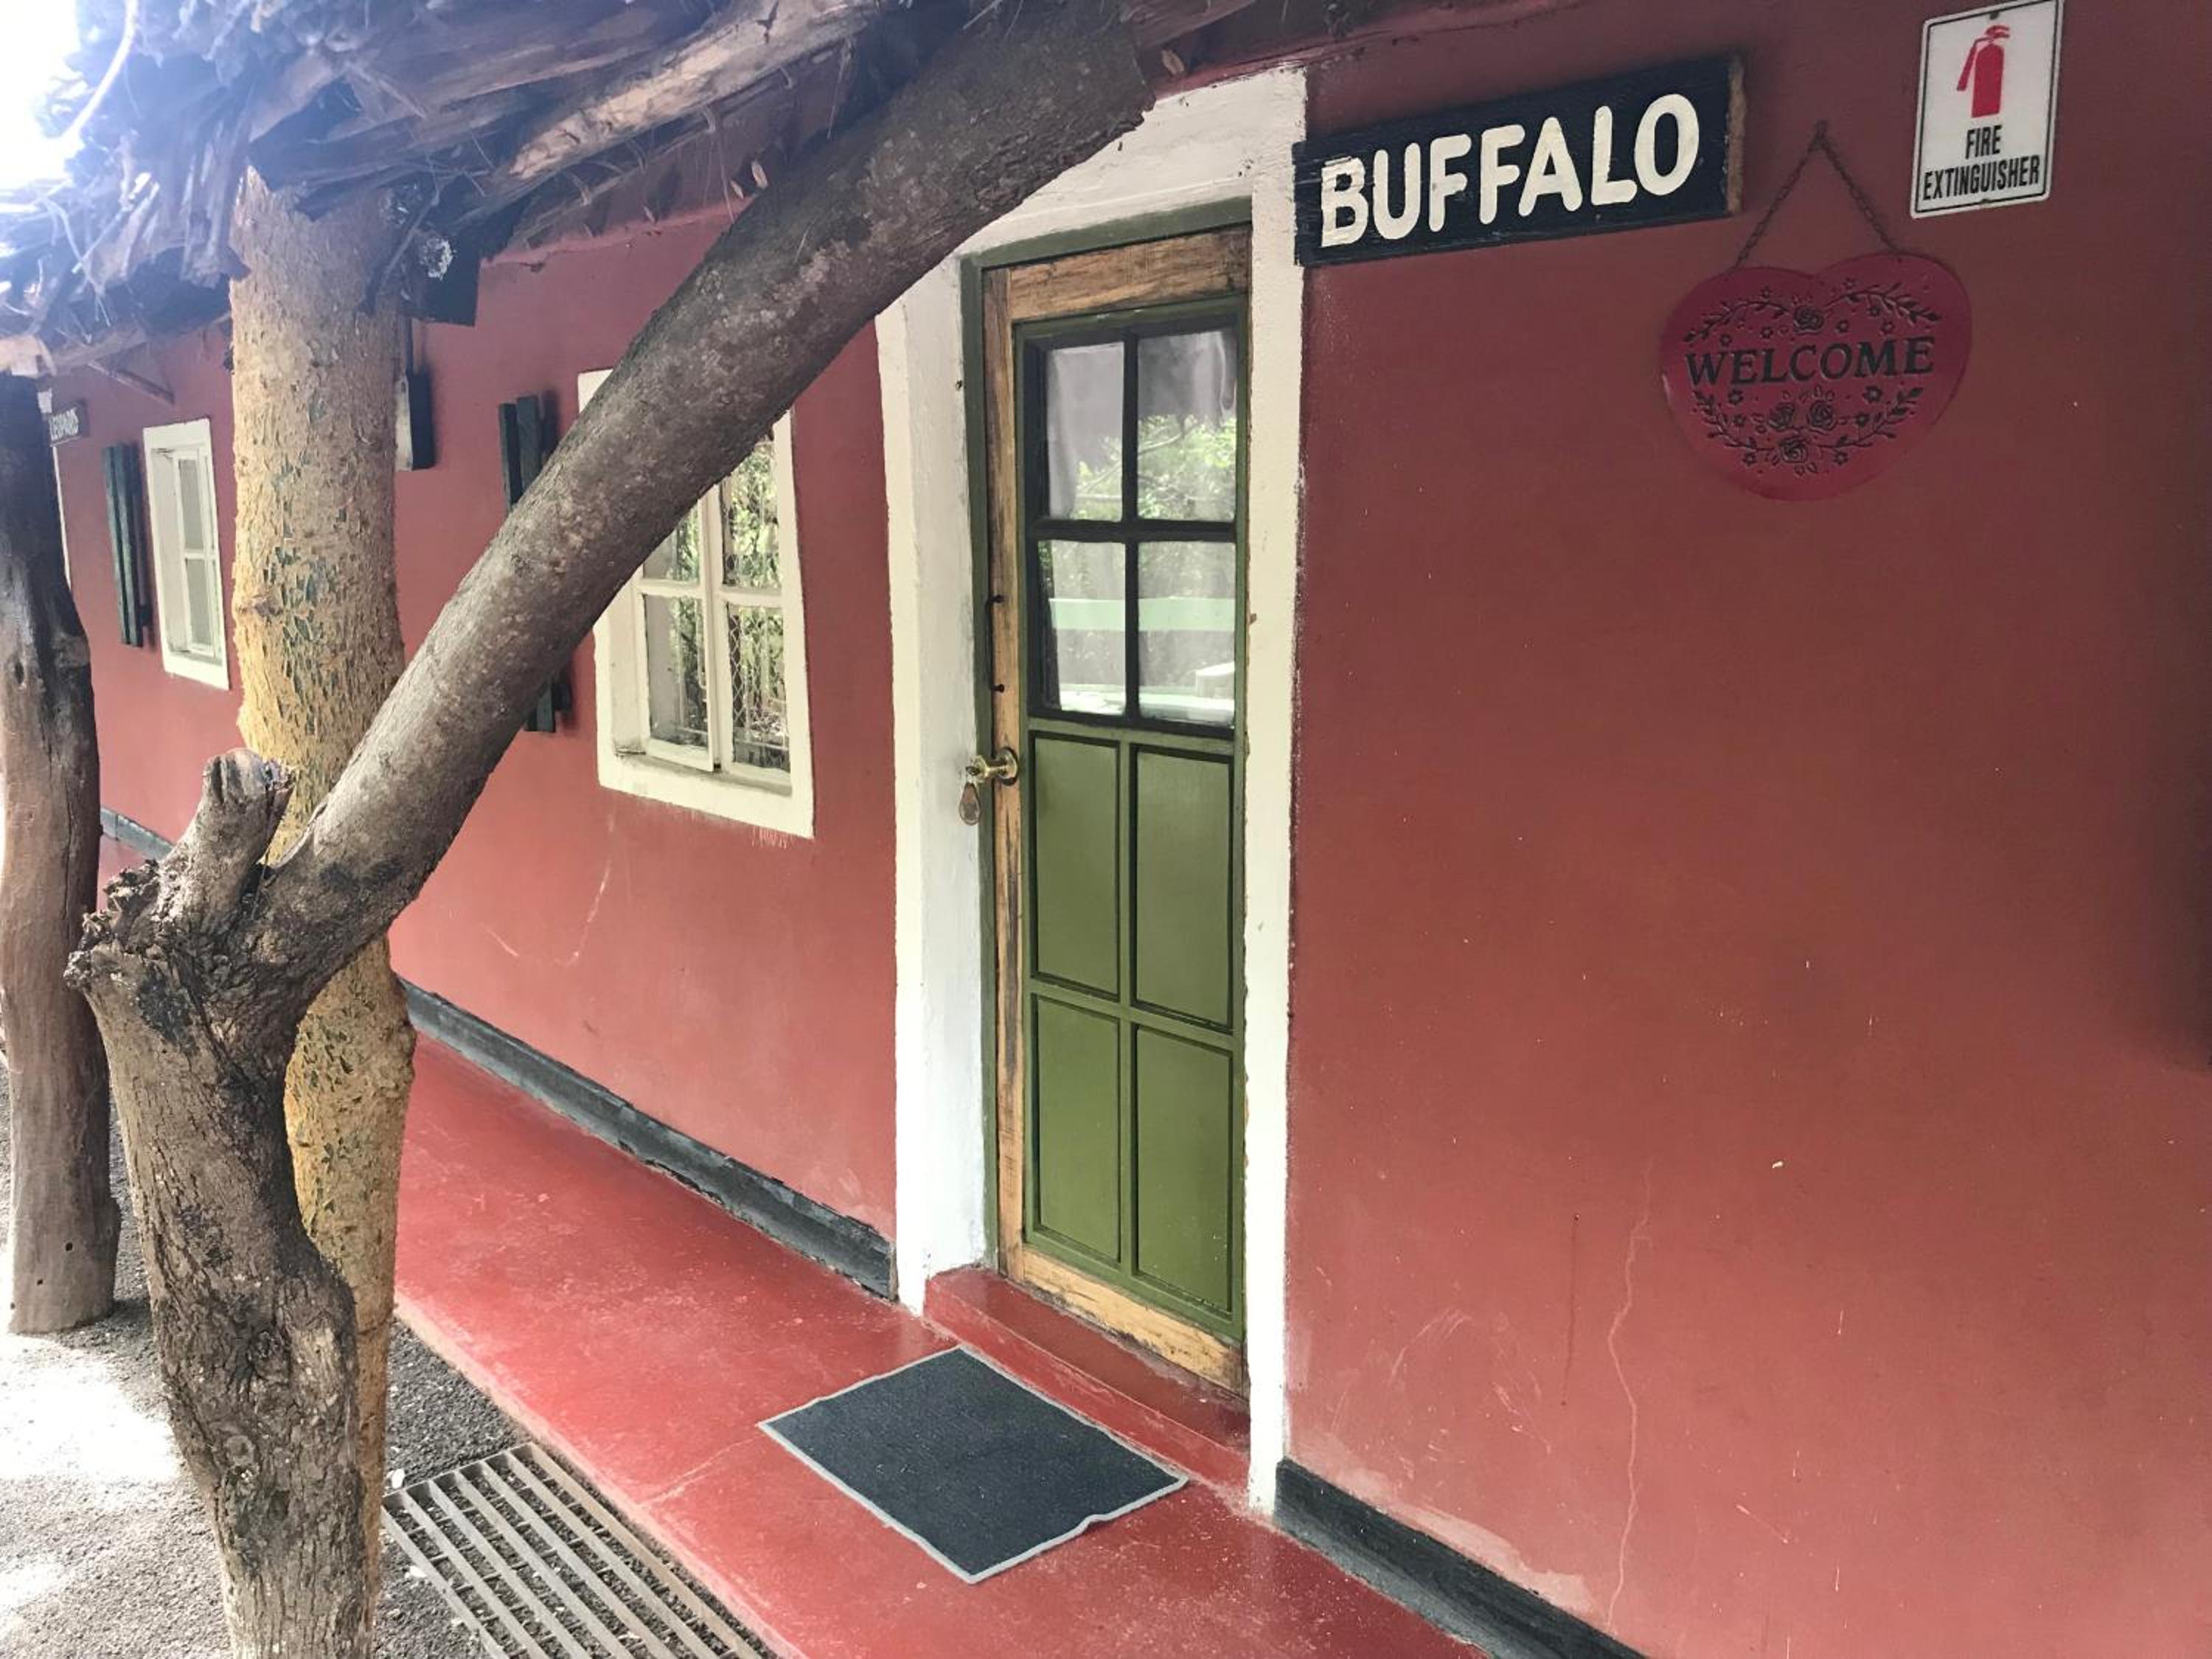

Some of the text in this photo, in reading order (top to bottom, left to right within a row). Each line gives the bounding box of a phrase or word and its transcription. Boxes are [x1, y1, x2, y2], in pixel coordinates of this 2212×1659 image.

[1965, 124, 2003, 159] FIRE
[1321, 93, 1699, 248] BUFFALO
[1923, 154, 2040, 201] EXTINGUISHER
[1684, 335, 1935, 386] WELCOME
